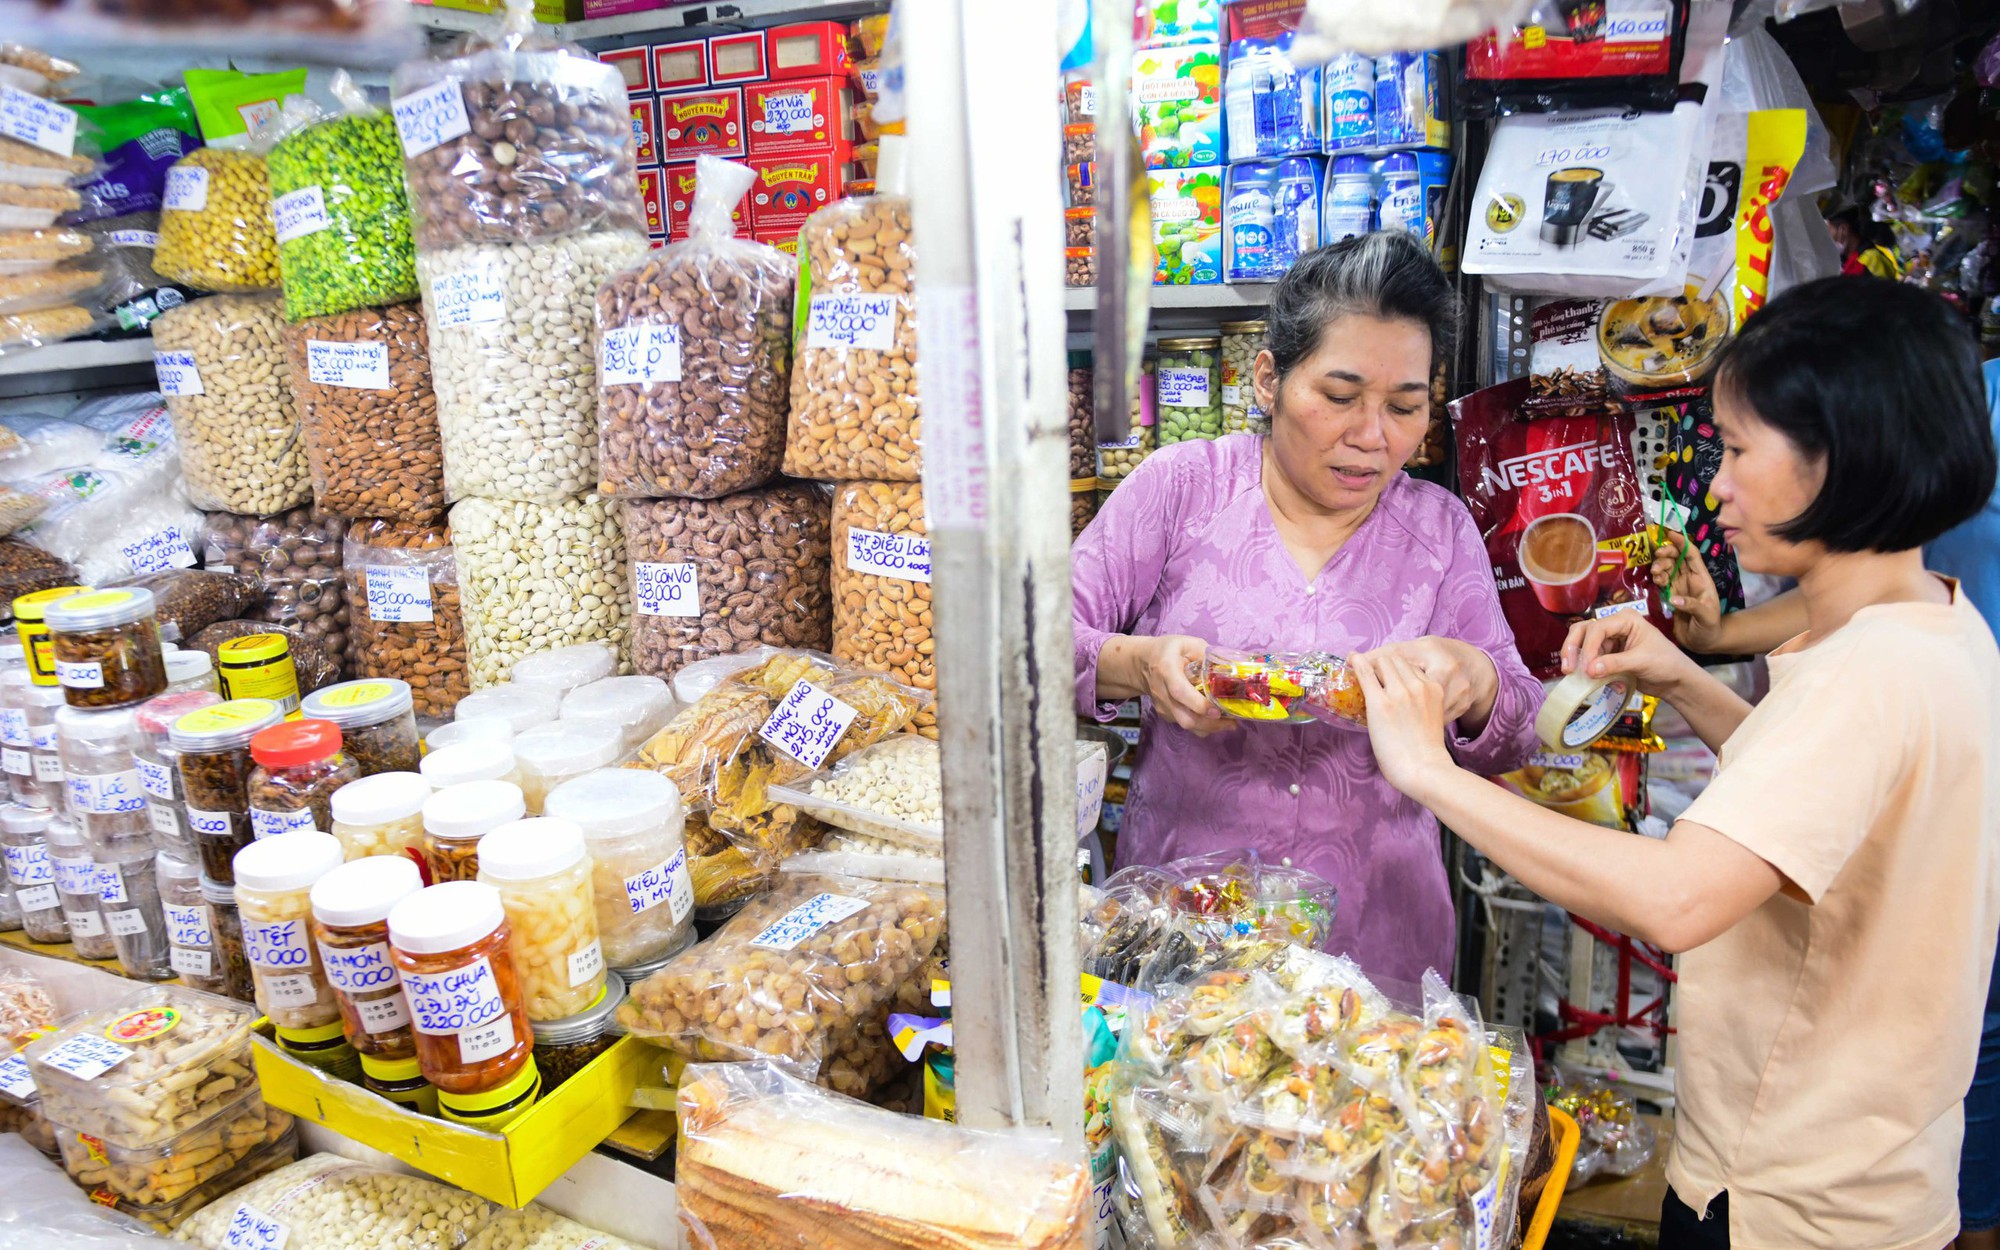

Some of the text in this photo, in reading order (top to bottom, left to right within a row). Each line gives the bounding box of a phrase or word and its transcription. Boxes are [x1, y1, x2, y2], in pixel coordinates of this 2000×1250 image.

[854, 545, 905, 569] 33.000
[1626, 536, 1646, 559] 24
[259, 921, 296, 946] TẾT
[403, 965, 487, 995] TÔM CHUA
[421, 996, 501, 1029] 220.000
